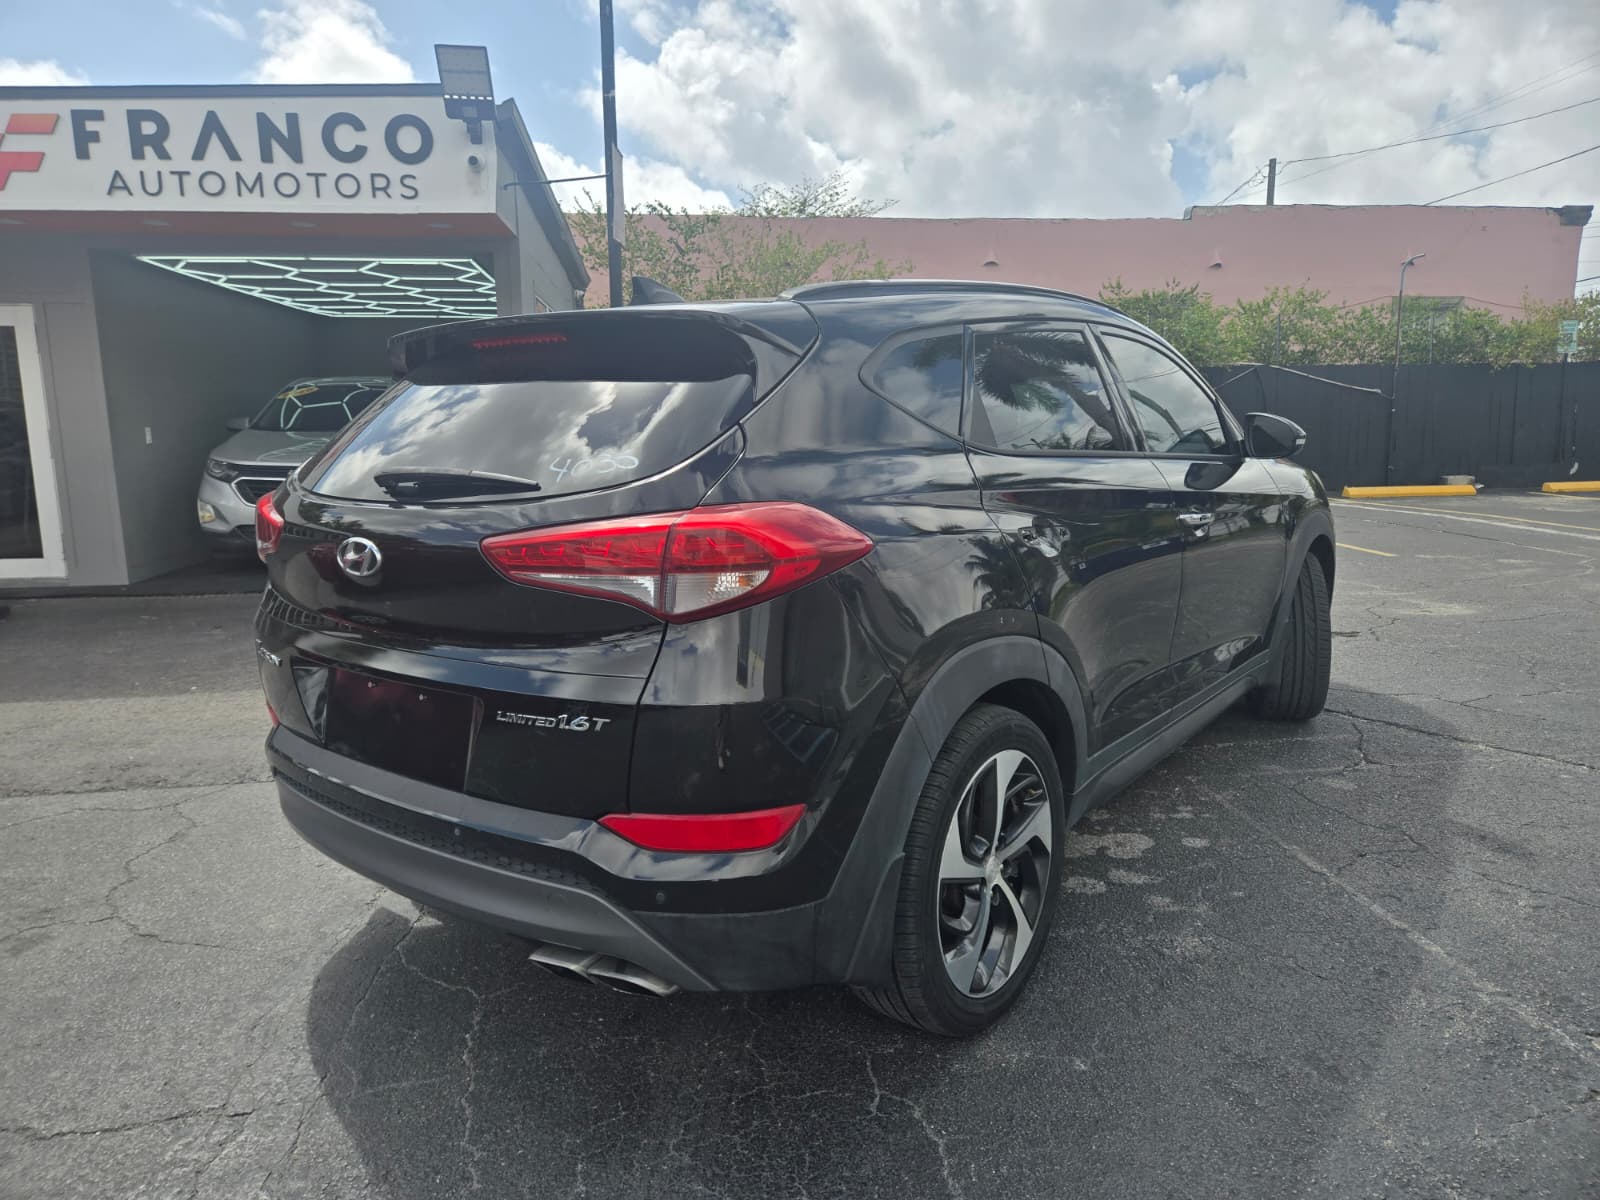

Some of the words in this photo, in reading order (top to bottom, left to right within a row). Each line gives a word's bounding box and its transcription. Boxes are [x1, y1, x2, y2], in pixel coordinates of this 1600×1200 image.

[70, 109, 435, 165] FRANCO
[106, 169, 420, 200] AUTOMOTORS
[496, 710, 556, 728] LIMITED
